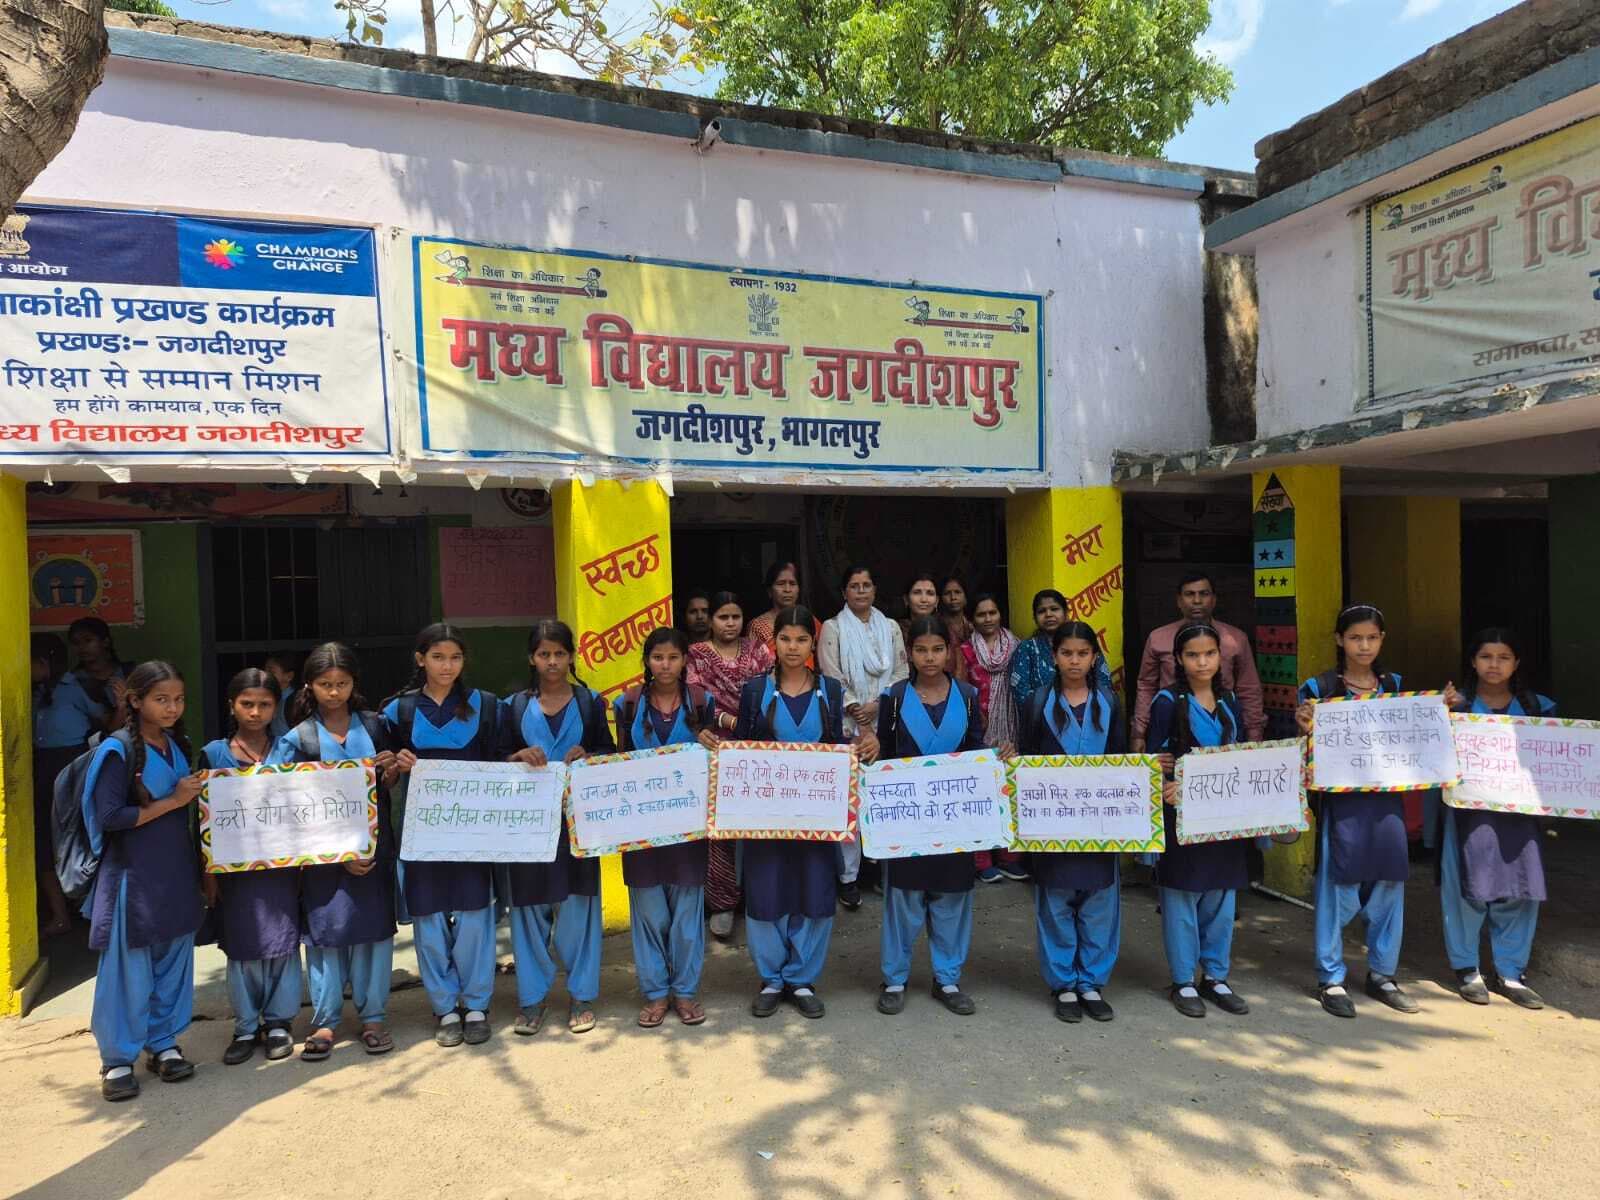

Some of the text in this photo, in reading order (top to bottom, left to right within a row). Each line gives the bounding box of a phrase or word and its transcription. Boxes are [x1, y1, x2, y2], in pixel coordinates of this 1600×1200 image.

[255, 243, 358, 260] CHAMPIONS
[1387, 216, 1499, 300] मध्य
[7, 261, 70, 276] आयोग
[272, 259, 344, 274] CHANGE
[482, 265, 565, 283] शिक्षा का अधिकार
[773, 281, 797, 293] 1932
[111, 298, 209, 325] प्रखण्ड
[217, 296, 336, 330] कार्यक्रम
[155, 330, 288, 365] जगदीशपुर
[2, 358, 322, 393] शिक्षा से सम्मान मिशन
[442, 312, 1021, 429] मध्य विद्यालय जगदीशपुर
[53, 399, 80, 414] हम
[86, 395, 120, 414] होंगे
[250, 398, 283, 416] दिन
[48, 419, 189, 442] विद्यालय
[196, 421, 365, 449] जगदीशपुर
[782, 415, 881, 459] भागलपुर
[1061, 523, 1104, 566] मेरा
[579, 533, 660, 596] स्वच्छ
[578, 593, 673, 672] विद्यालय
[1573, 743, 1594, 757] का
[1350, 753, 1374, 769] का
[644, 777, 668, 792] नारा
[721, 785, 734, 798] घर
[584, 807, 614, 822] भारत
[924, 800, 940, 819] को
